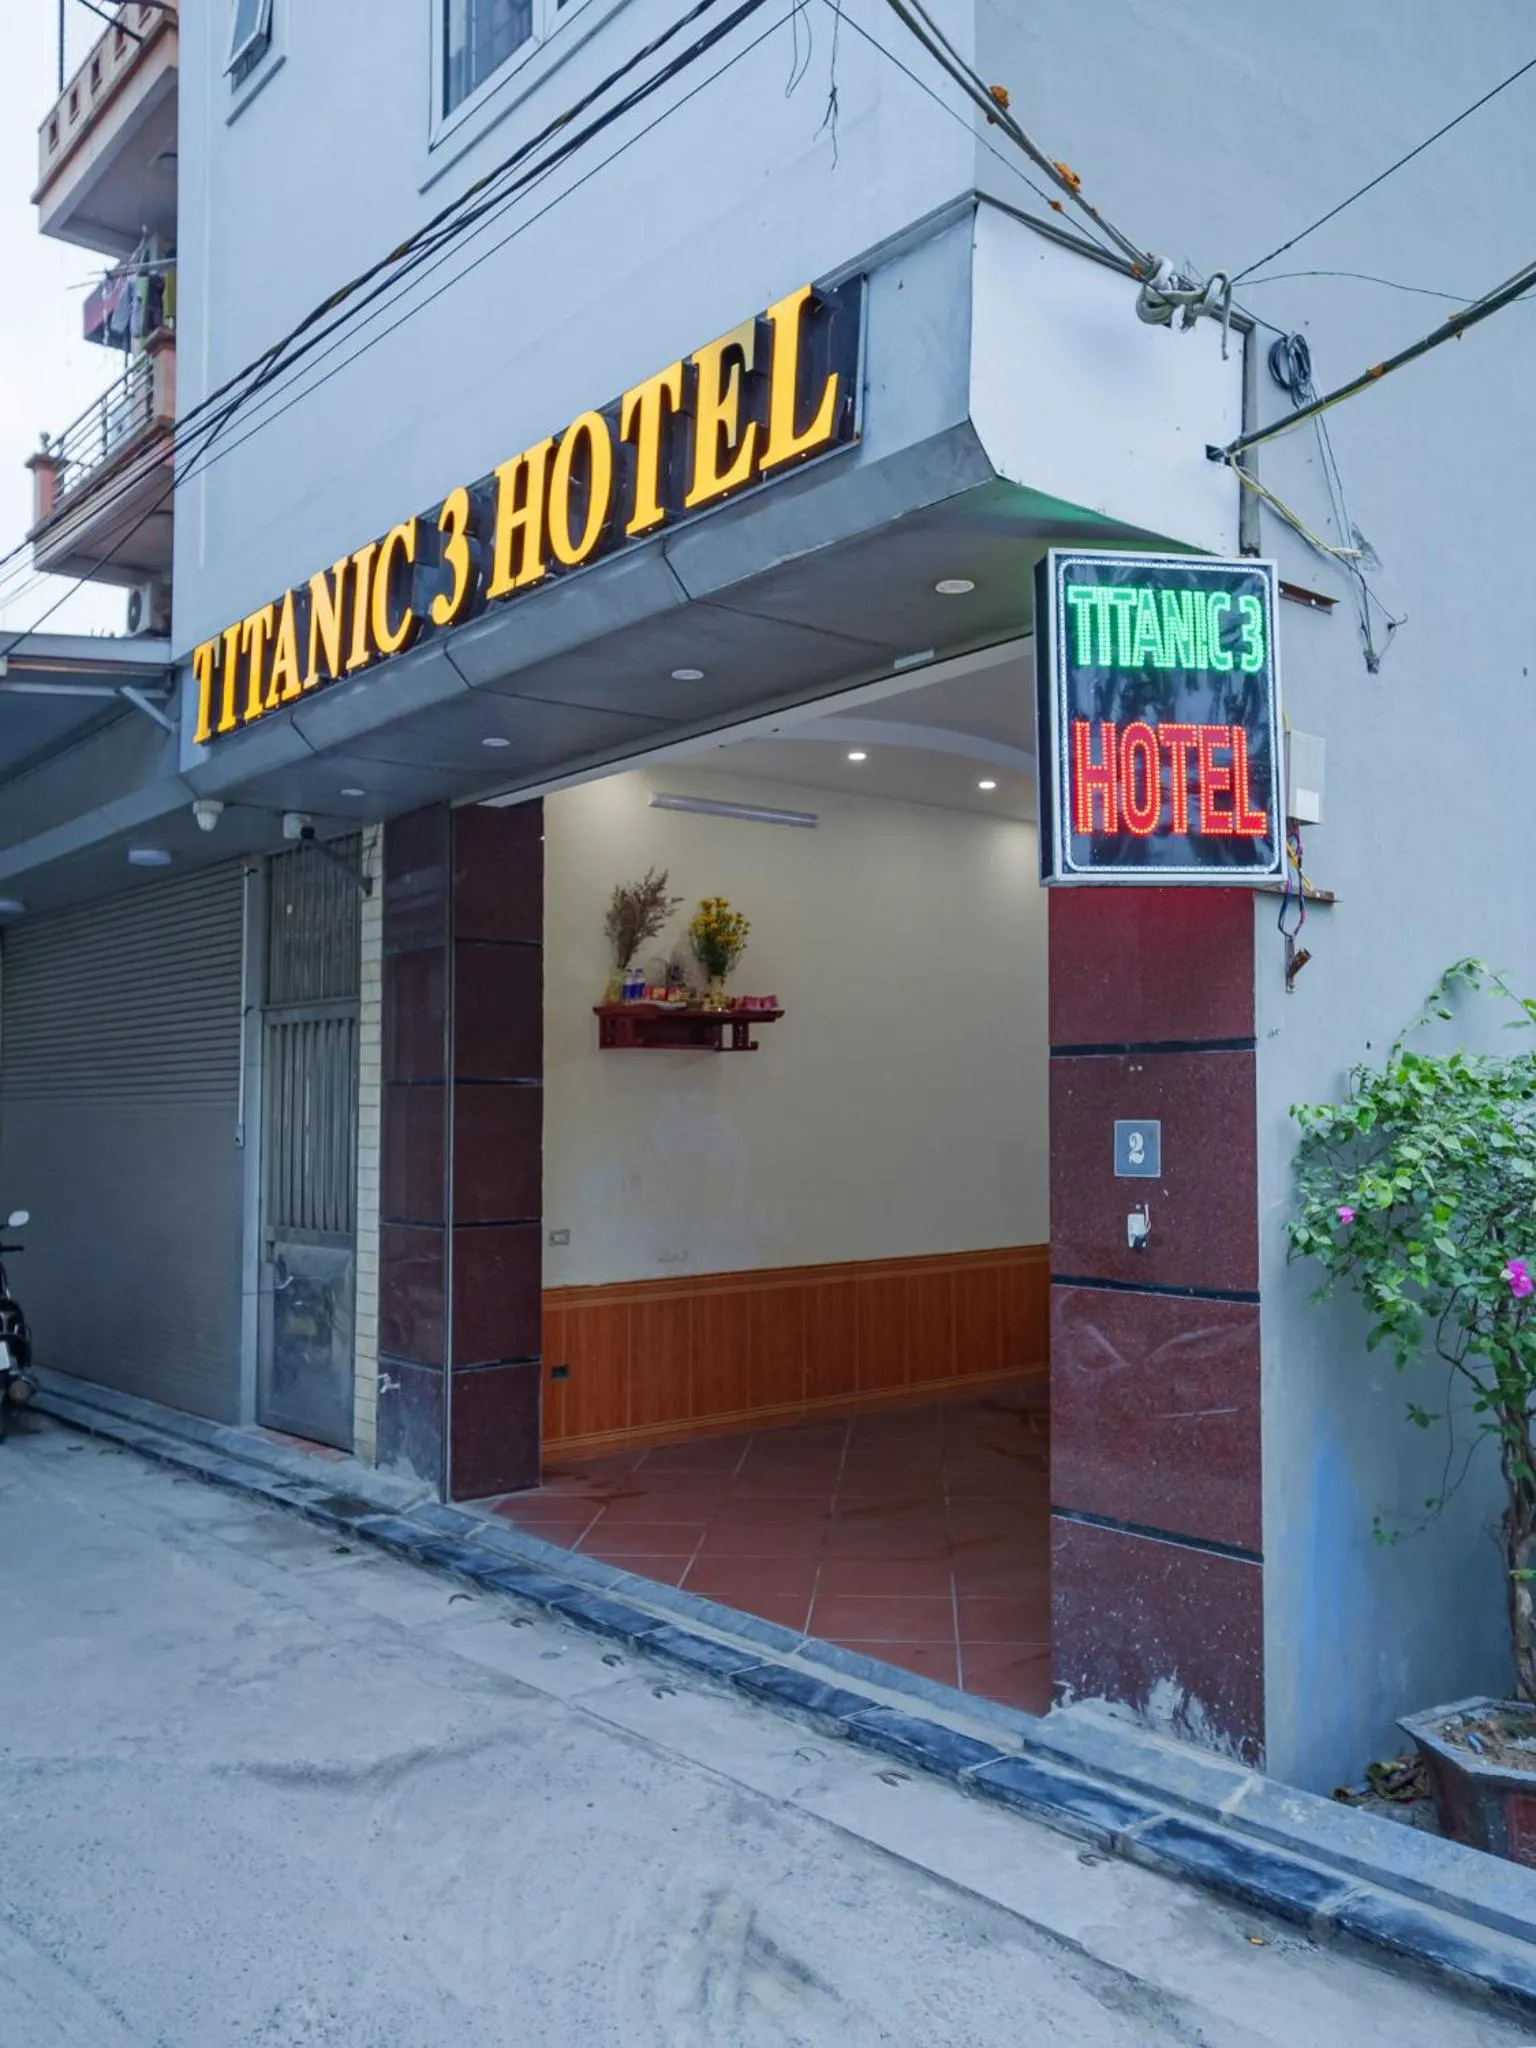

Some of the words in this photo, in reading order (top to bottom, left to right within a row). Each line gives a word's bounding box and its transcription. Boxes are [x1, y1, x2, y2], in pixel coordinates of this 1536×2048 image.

[193, 516, 416, 743] TITANIC
[432, 487, 469, 625] 3
[486, 283, 839, 600] HOTEL
[1067, 585, 1234, 671] TITANIC
[1239, 594, 1265, 673] 3
[1072, 721, 1268, 835] HOTEL
[1128, 1131, 1145, 1165] 2
